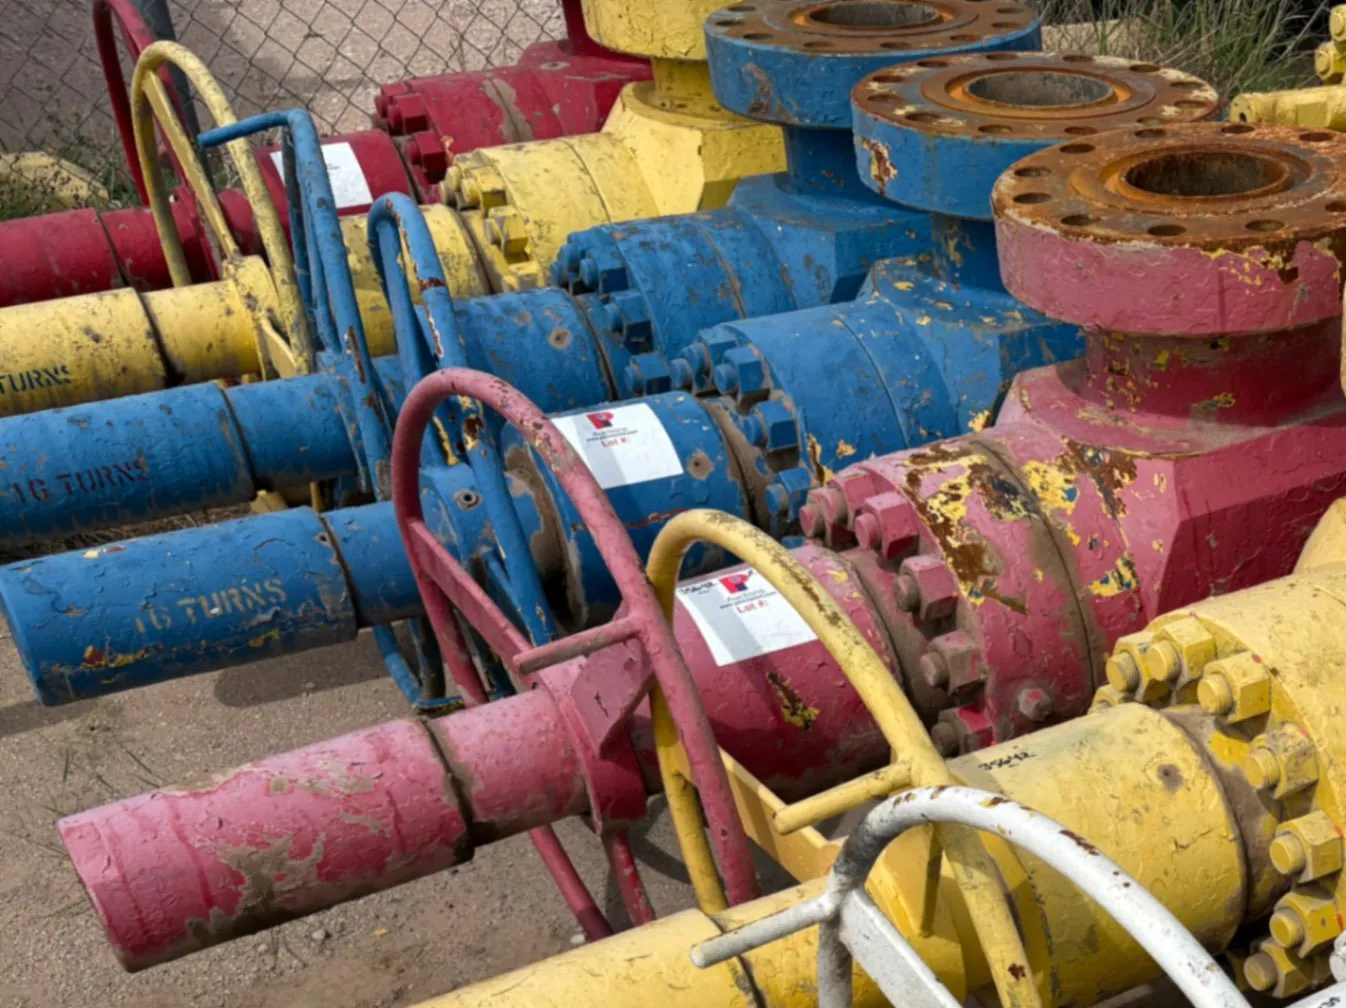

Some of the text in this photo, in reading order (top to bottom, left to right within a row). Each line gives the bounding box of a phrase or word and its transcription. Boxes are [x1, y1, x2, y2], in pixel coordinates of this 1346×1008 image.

[56, 459, 150, 495] TURNS
[177, 578, 287, 624] TURNS
[736, 603, 757, 614] Lot
